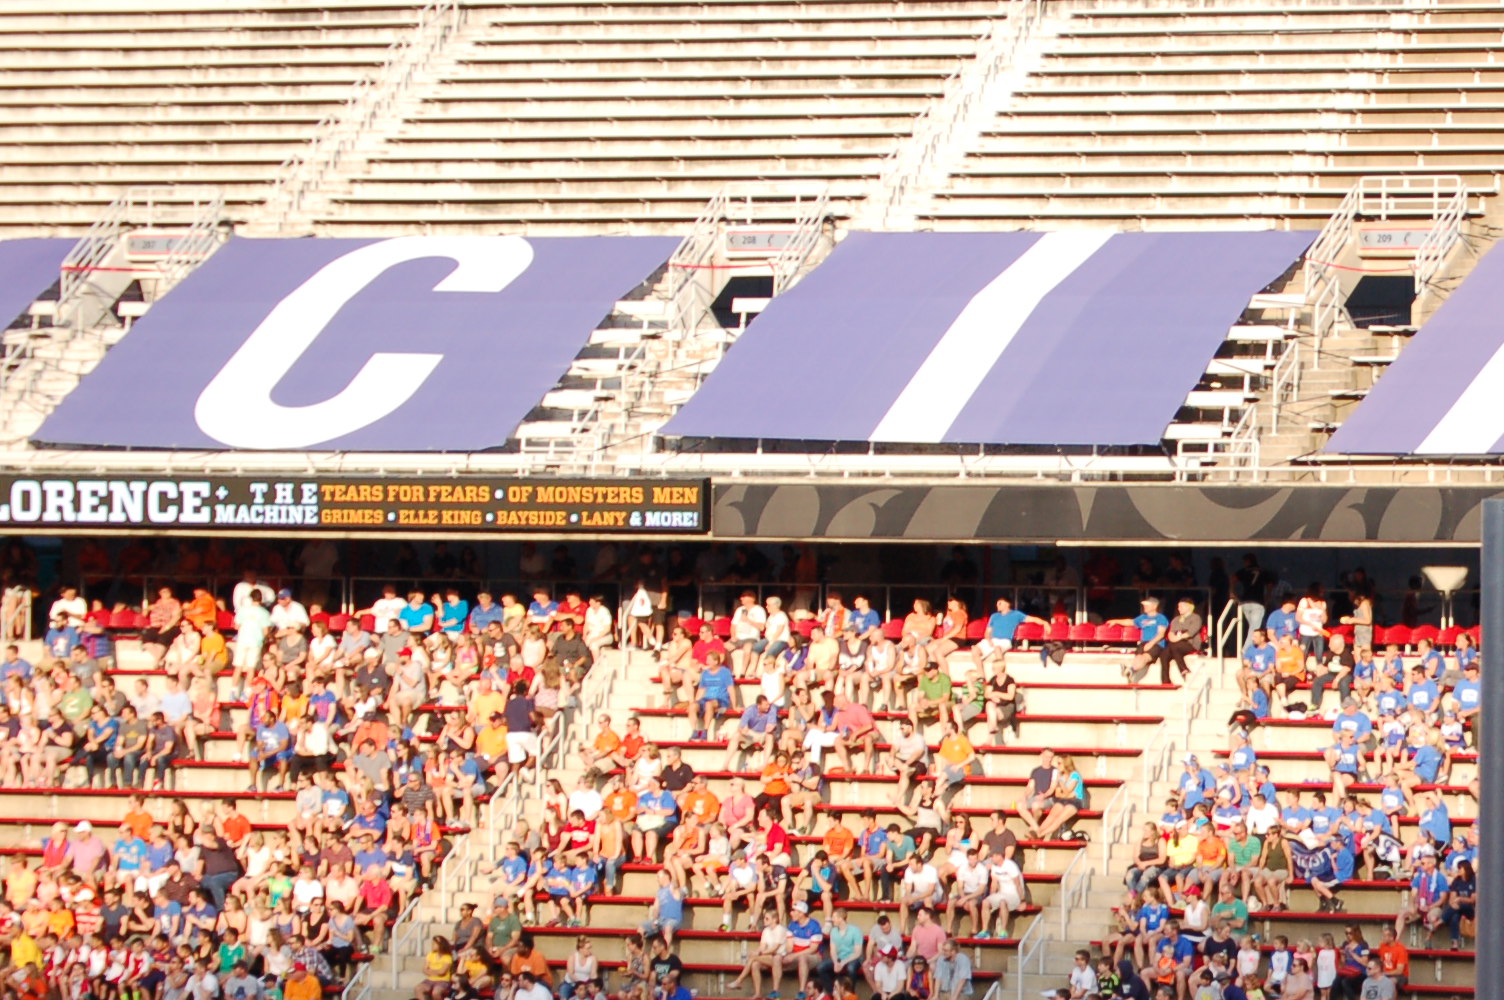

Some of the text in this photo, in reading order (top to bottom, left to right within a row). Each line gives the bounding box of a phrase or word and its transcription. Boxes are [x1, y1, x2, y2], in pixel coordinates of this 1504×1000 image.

[1377, 233, 1392, 243] 209
[0, 480, 211, 523] ORENCE
[250, 483, 318, 504] THE
[321, 484, 699, 504] TEARS FOR FEARS OF MONSTERS MEN
[215, 504, 318, 524] MACHINE
[321, 509, 699, 527] GRIMES ELLE KING BAYSIDE LANY & MORE!
